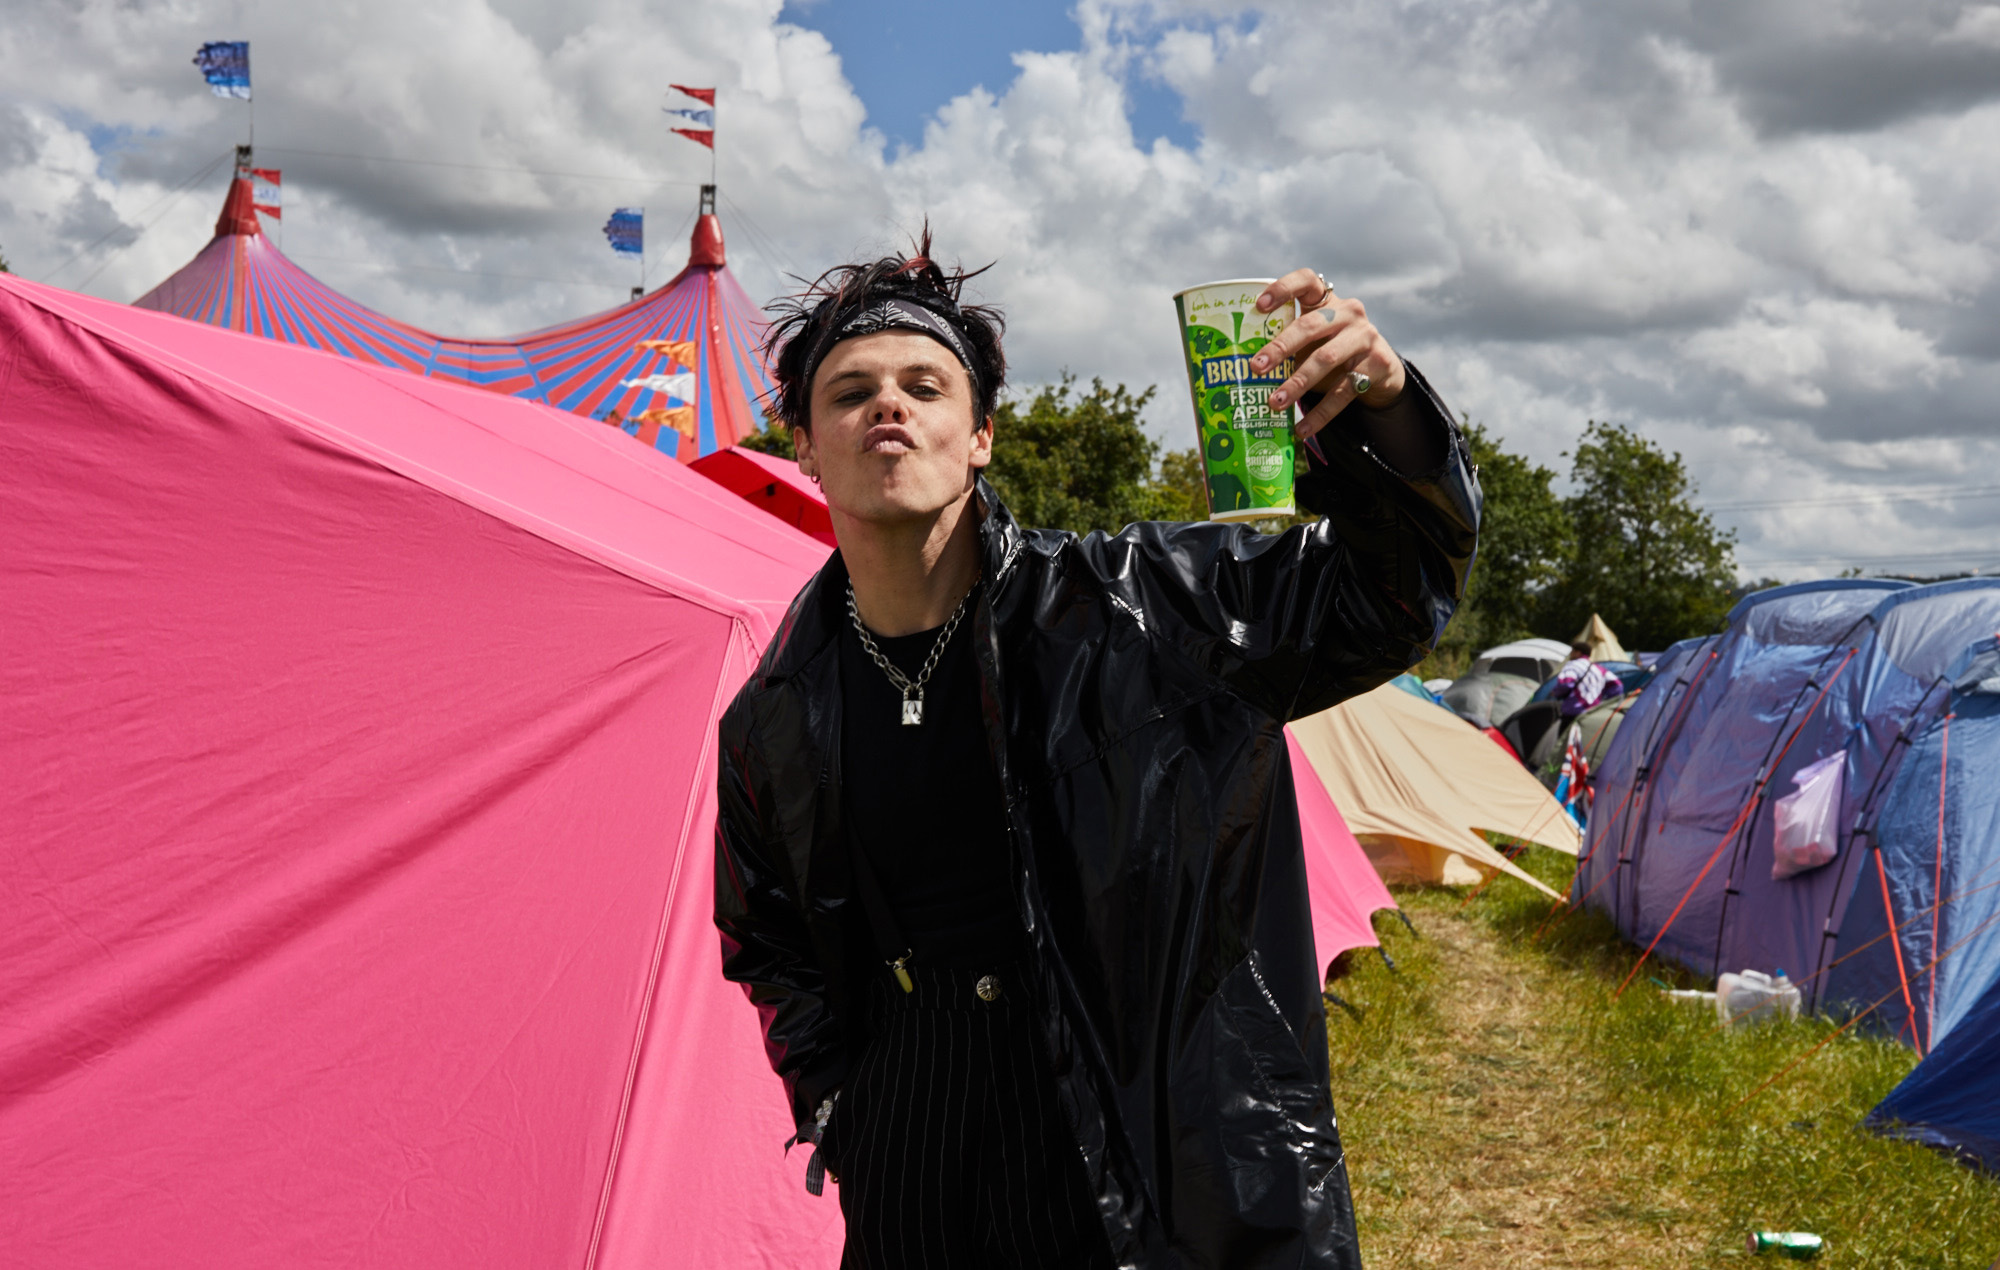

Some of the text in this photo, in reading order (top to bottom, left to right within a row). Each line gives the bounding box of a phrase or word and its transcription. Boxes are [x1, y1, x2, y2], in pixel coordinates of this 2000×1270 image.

[1214, 298, 1225, 307] in
[1233, 405, 1288, 420] APPLE
[1233, 421, 1268, 430] ENGLISH
[1245, 455, 1283, 467] BROTHERS
